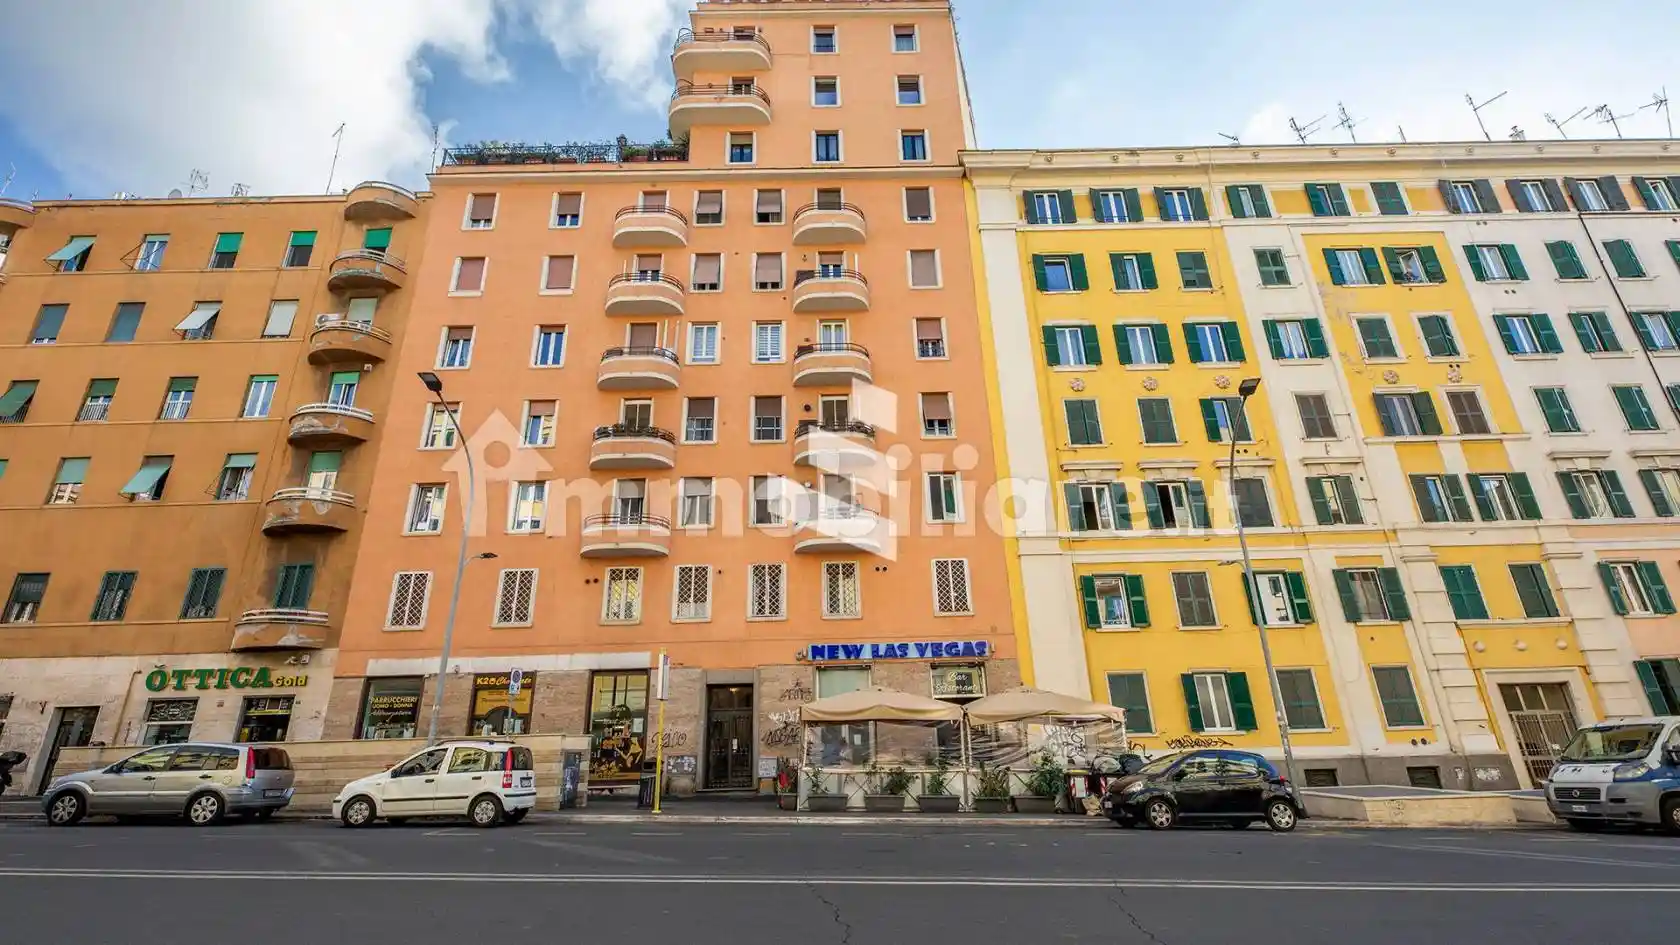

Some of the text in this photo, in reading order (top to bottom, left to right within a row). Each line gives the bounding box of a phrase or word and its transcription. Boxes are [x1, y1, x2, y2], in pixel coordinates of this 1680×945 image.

[811, 640, 987, 660] NEW LAS VEGAS
[948, 671, 968, 681] Bar
[273, 676, 308, 688] Gold
[370, 695, 418, 704] PARRUCCHIERI
